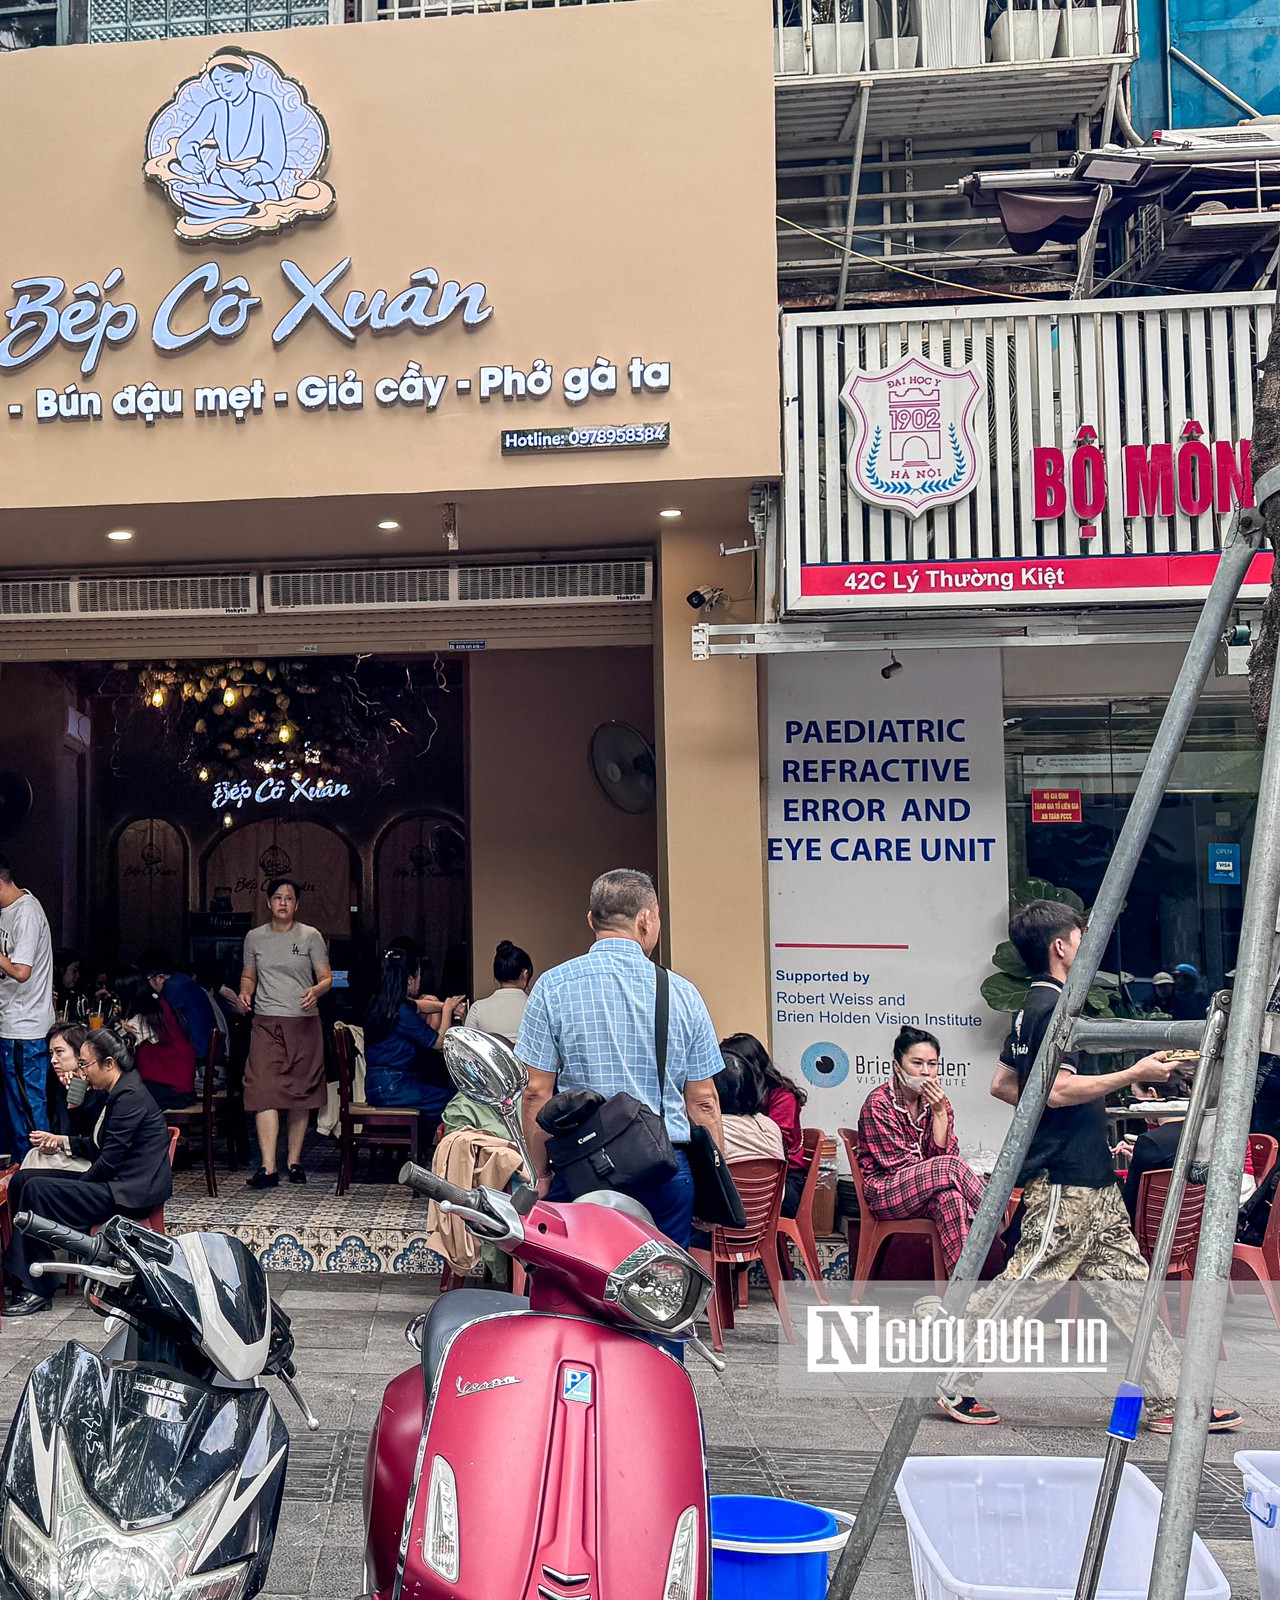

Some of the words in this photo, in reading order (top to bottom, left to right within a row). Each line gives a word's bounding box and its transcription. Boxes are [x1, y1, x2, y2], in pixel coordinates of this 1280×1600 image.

[152, 262, 262, 355] Cô
[272, 256, 493, 346] Xuân
[36, 384, 102, 423] Bún
[112, 382, 183, 427] đậu
[194, 379, 266, 423] mẹt
[296, 369, 364, 411] Giả
[374, 360, 448, 411] cầy
[480, 359, 552, 401] Phở
[564, 356, 618, 405] gà
[628, 356, 671, 391] ta
[934, 378, 941, 387] Y
[889, 408, 941, 430] 1902
[505, 431, 565, 449] Hotline:
[568, 427, 666, 446] 0978958384
[890, 469, 910, 480] HÀ
[916, 468, 942, 480] NỘI
[1032, 424, 1106, 539] BỘ
[1122, 419, 1255, 518] MÔN
[844, 571, 887, 592] 42C
[893, 566, 920, 594] Lý
[925, 564, 1014, 591] Thường
[1021, 566, 1065, 590] Kiệt
[785, 718, 966, 743] PAEDIATRIC
[782, 758, 970, 783] REFRACTIVE
[784, 798, 885, 822] ERROR
[901, 798, 971, 822] AND
[768, 837, 821, 861] EYE
[830, 837, 912, 862] CARE
[920, 838, 996, 862] UNIT
[776, 969, 849, 984] Supported
[853, 970, 870, 986] by
[777, 992, 825, 1005] Robert
[829, 992, 874, 1006] Weiss
[877, 993, 905, 1006] and
[777, 1010, 814, 1024] Brien
[819, 1011, 871, 1025] Holden
[875, 1011, 920, 1026] Vision
[924, 1012, 982, 1027] Institute
[133, 1381, 188, 1405] HONDA
[455, 1375, 523, 1398] Vespa
